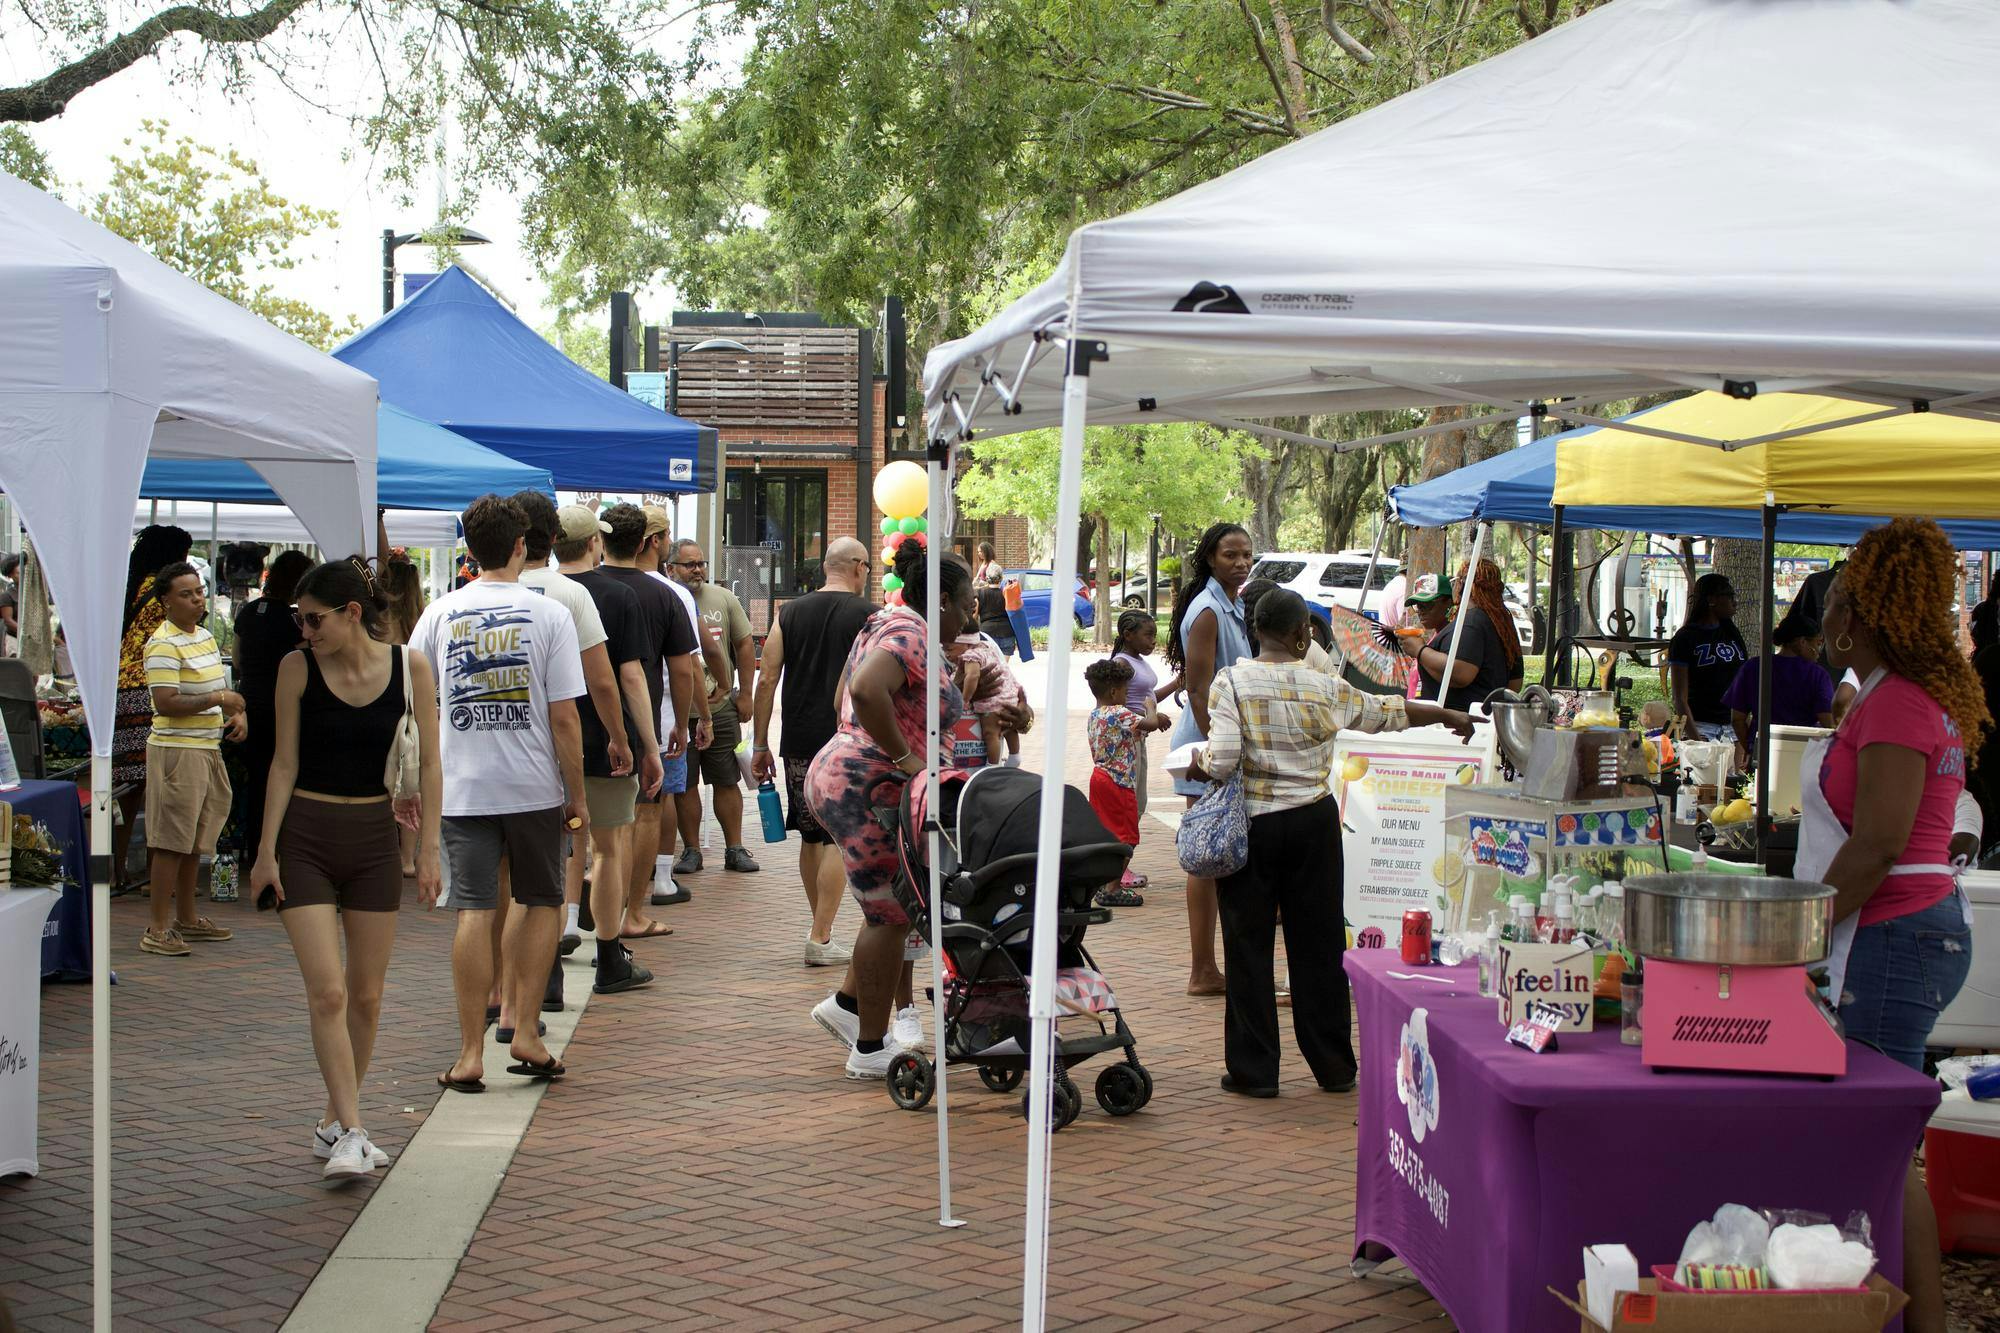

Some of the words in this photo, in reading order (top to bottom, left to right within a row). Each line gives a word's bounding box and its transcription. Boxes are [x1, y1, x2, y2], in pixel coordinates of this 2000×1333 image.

[451, 621, 472, 640] WE
[474, 628, 522, 656] LOVE
[471, 673, 488, 685] OUR
[486, 668, 530, 690] BLUES
[473, 705, 503, 722] STEP
[506, 705, 530, 721] ONE
[476, 721, 512, 732] AUTOMOTIVE
[1411, 770, 1446, 779] MAIN
[1381, 818, 1397, 829] OUR
[1398, 819, 1421, 831] MENU
[1371, 836, 1381, 845] MY
[1382, 836, 1398, 847] MAIN
[1399, 838, 1426, 848] SQUEEZE
[1370, 858, 1394, 869] TRIPPLE
[1395, 860, 1422, 870] SQUEEZE
[1360, 884, 1401, 896] STRAWBERRY
[1401, 888, 1430, 898] SQUEEZE
[1357, 930, 1382, 949] $10
[1514, 967, 1590, 993] feelin
[1389, 1128, 1449, 1229] 352-575-4087
